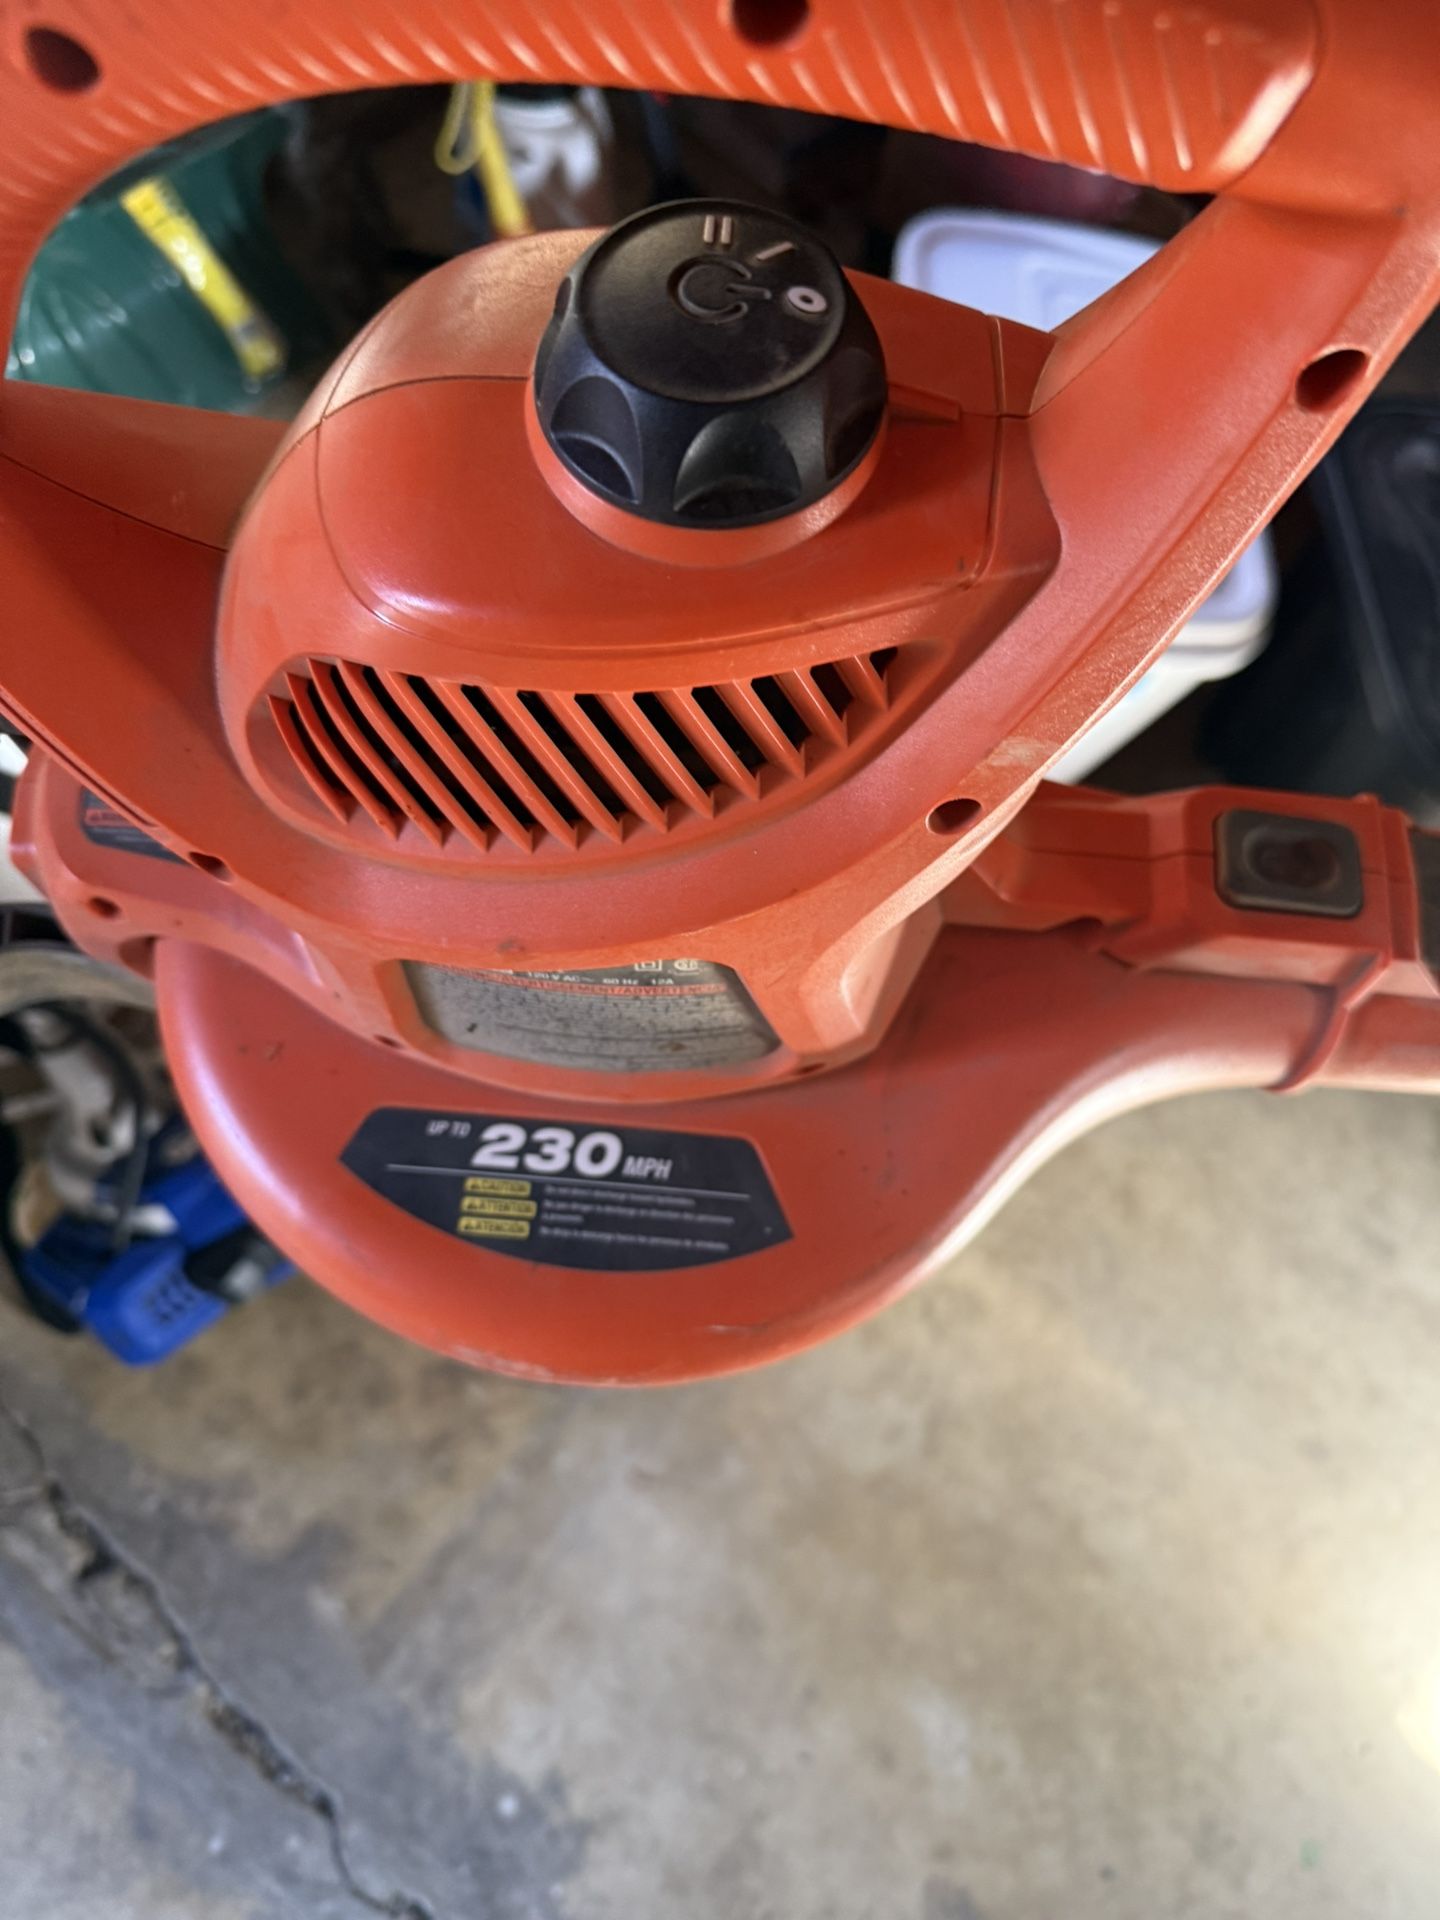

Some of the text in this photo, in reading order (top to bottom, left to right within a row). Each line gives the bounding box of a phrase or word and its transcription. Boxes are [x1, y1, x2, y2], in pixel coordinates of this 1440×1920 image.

[426, 1120, 672, 1180] UP TO 230 MPH
